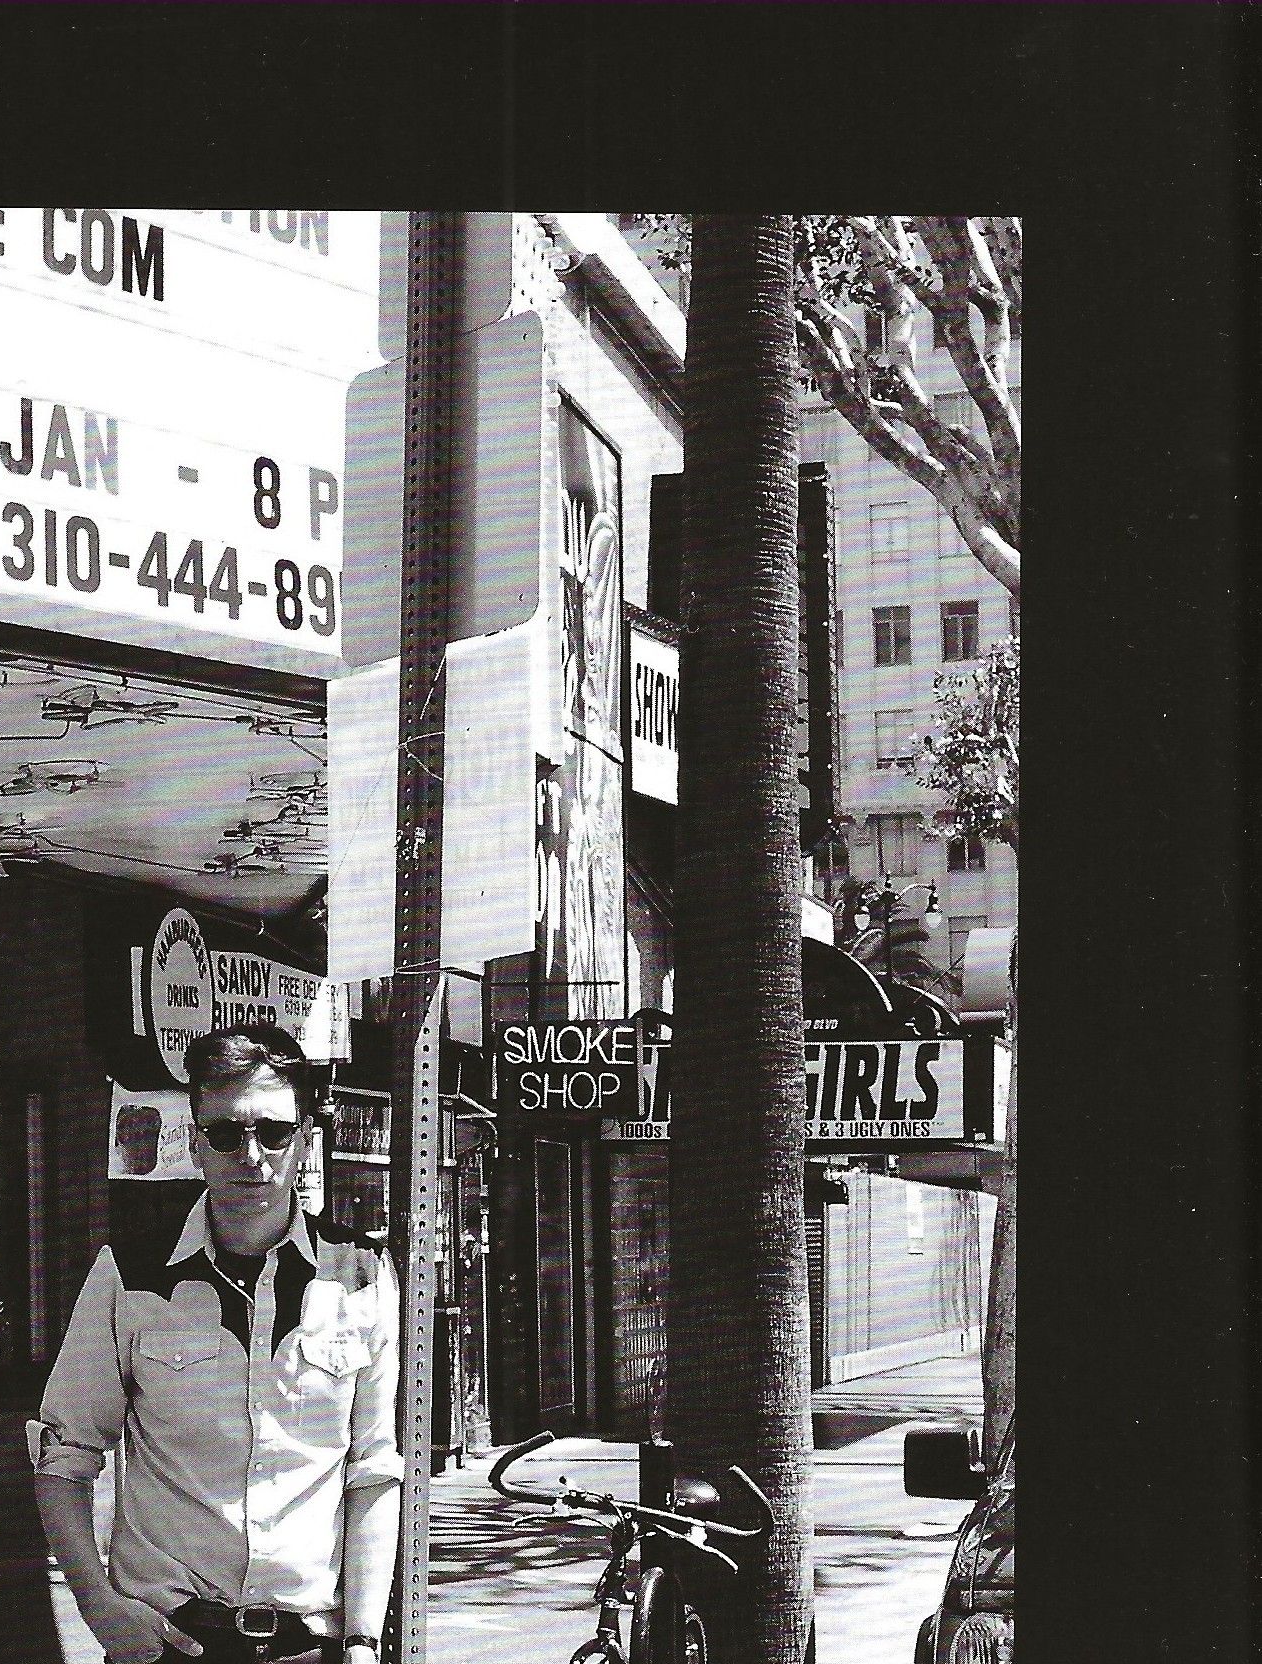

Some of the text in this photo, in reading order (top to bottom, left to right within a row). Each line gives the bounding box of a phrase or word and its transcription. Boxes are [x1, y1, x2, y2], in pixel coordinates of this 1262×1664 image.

[0, 397, 119, 496] JAN
[253, 456, 281, 529] 8
[2, 501, 343, 637] 310-444-89
[167, 983, 199, 1009] DRINKS
[217, 954, 272, 999] SANDY
[278, 974, 300, 998] FREE
[503, 1025, 635, 1066] SMOKE
[519, 1070, 621, 1111] SHOP
[619, 1122, 662, 1139] 1000s
[819, 1122, 830, 1138] &
[835, 1121, 845, 1138] 3
[850, 1121, 885, 1138] UGLY
[890, 1121, 931, 1138] ONES
